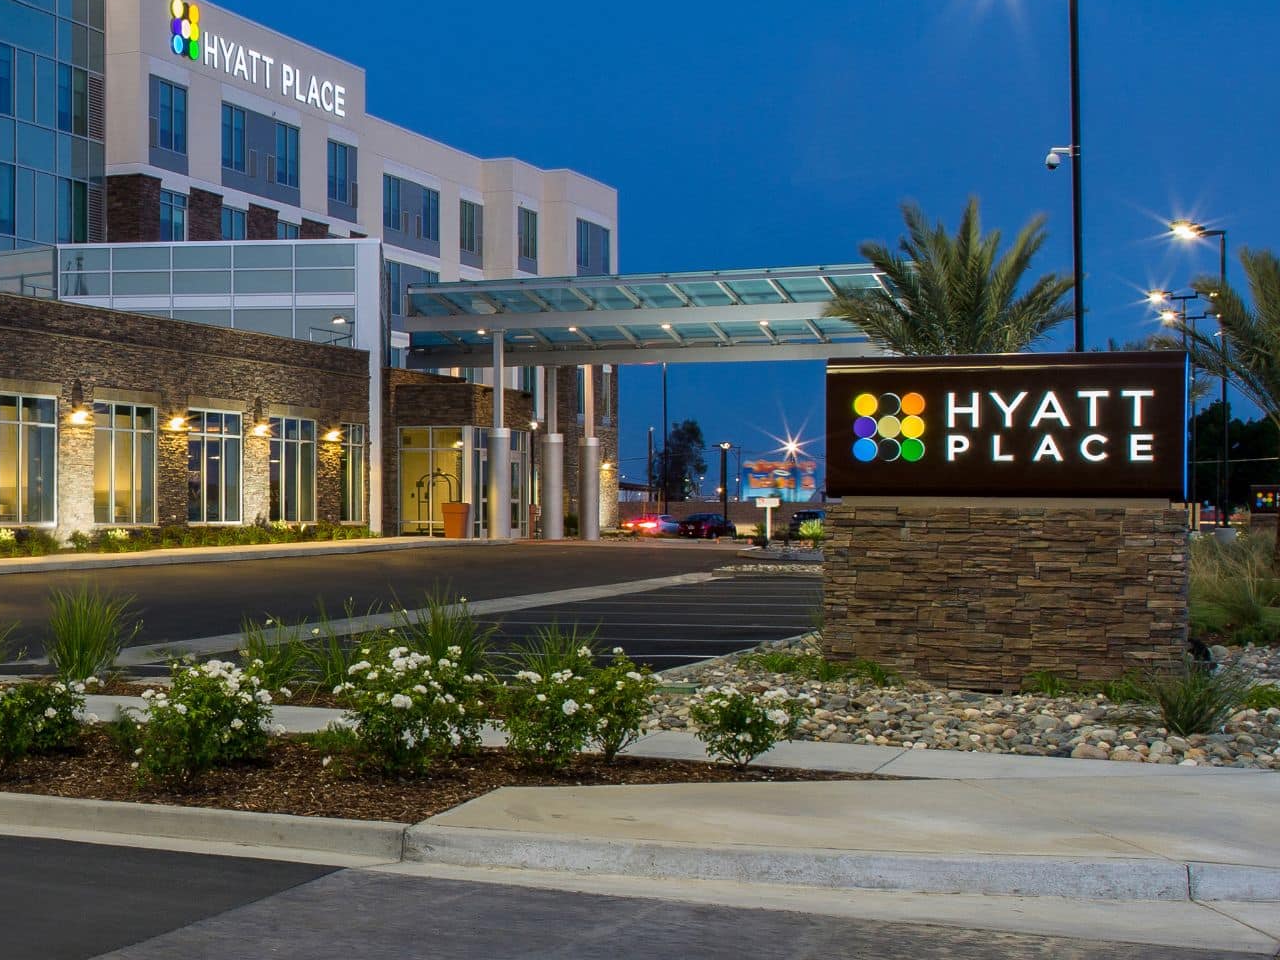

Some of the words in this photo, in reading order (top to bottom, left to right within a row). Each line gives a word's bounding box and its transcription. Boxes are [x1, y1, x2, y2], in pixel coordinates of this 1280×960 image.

[203, 31, 274, 89] HYATT
[282, 63, 346, 117] PLACE
[946, 389, 1155, 429] HYATT
[946, 434, 1155, 462] PLACE
